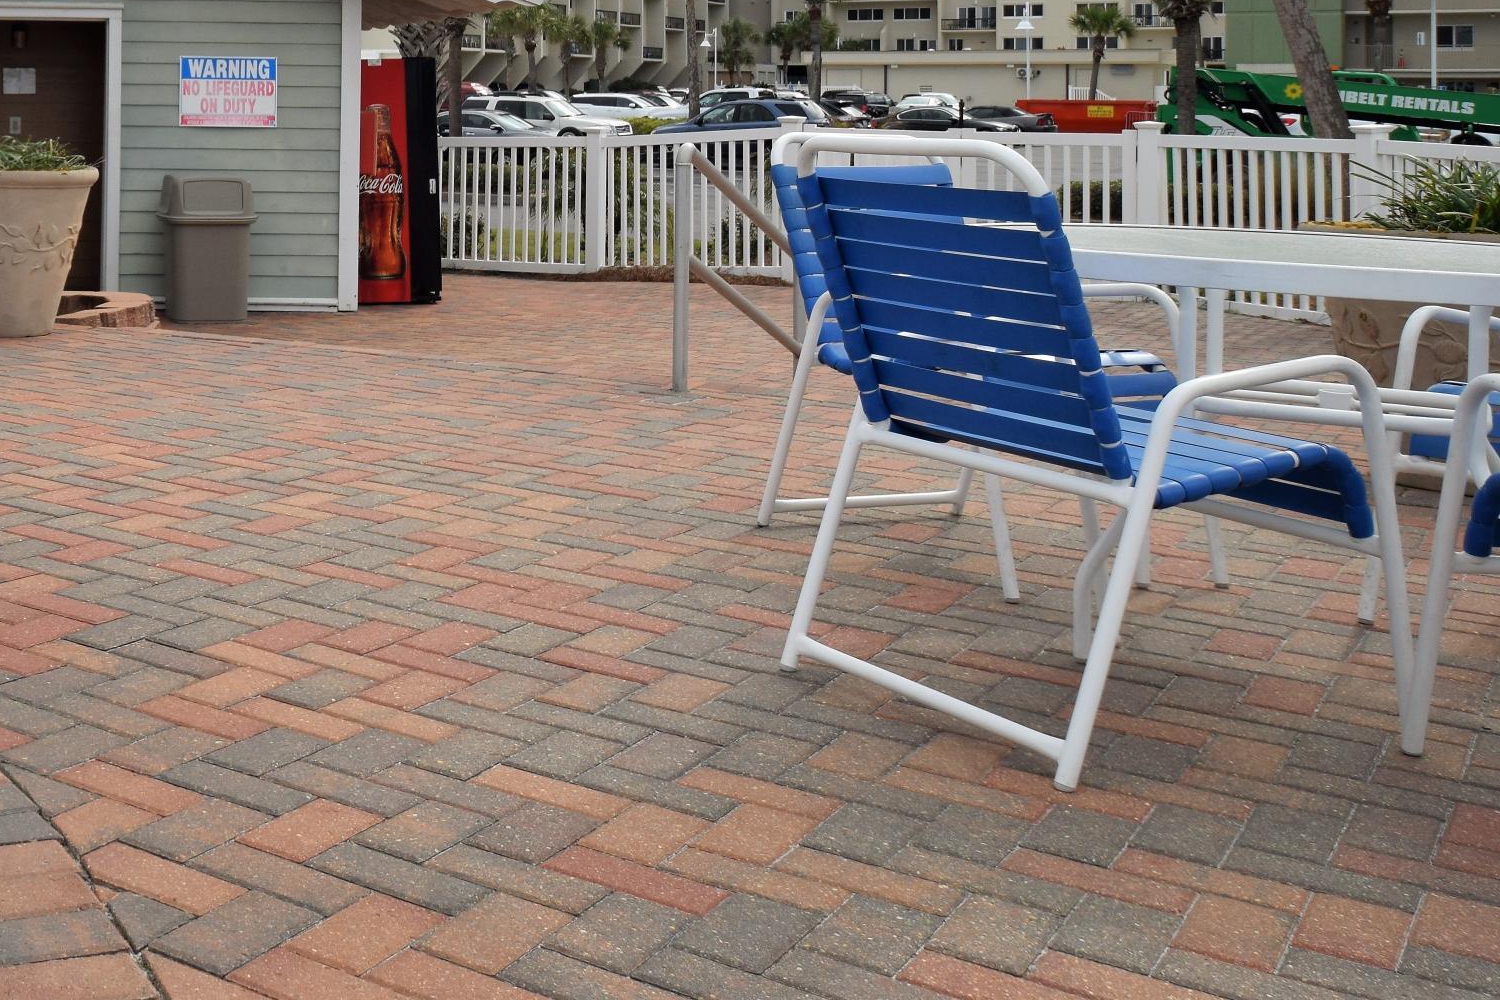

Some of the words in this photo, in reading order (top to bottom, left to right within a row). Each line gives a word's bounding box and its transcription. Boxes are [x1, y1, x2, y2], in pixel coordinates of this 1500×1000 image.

[188, 58, 270, 79] WARNING
[182, 80, 200, 97] NO
[205, 81, 275, 97] LIFEGUARD
[200, 99, 217, 114] ON
[223, 99, 256, 114] DUTY
[1391, 95, 1476, 115] RENTALS
